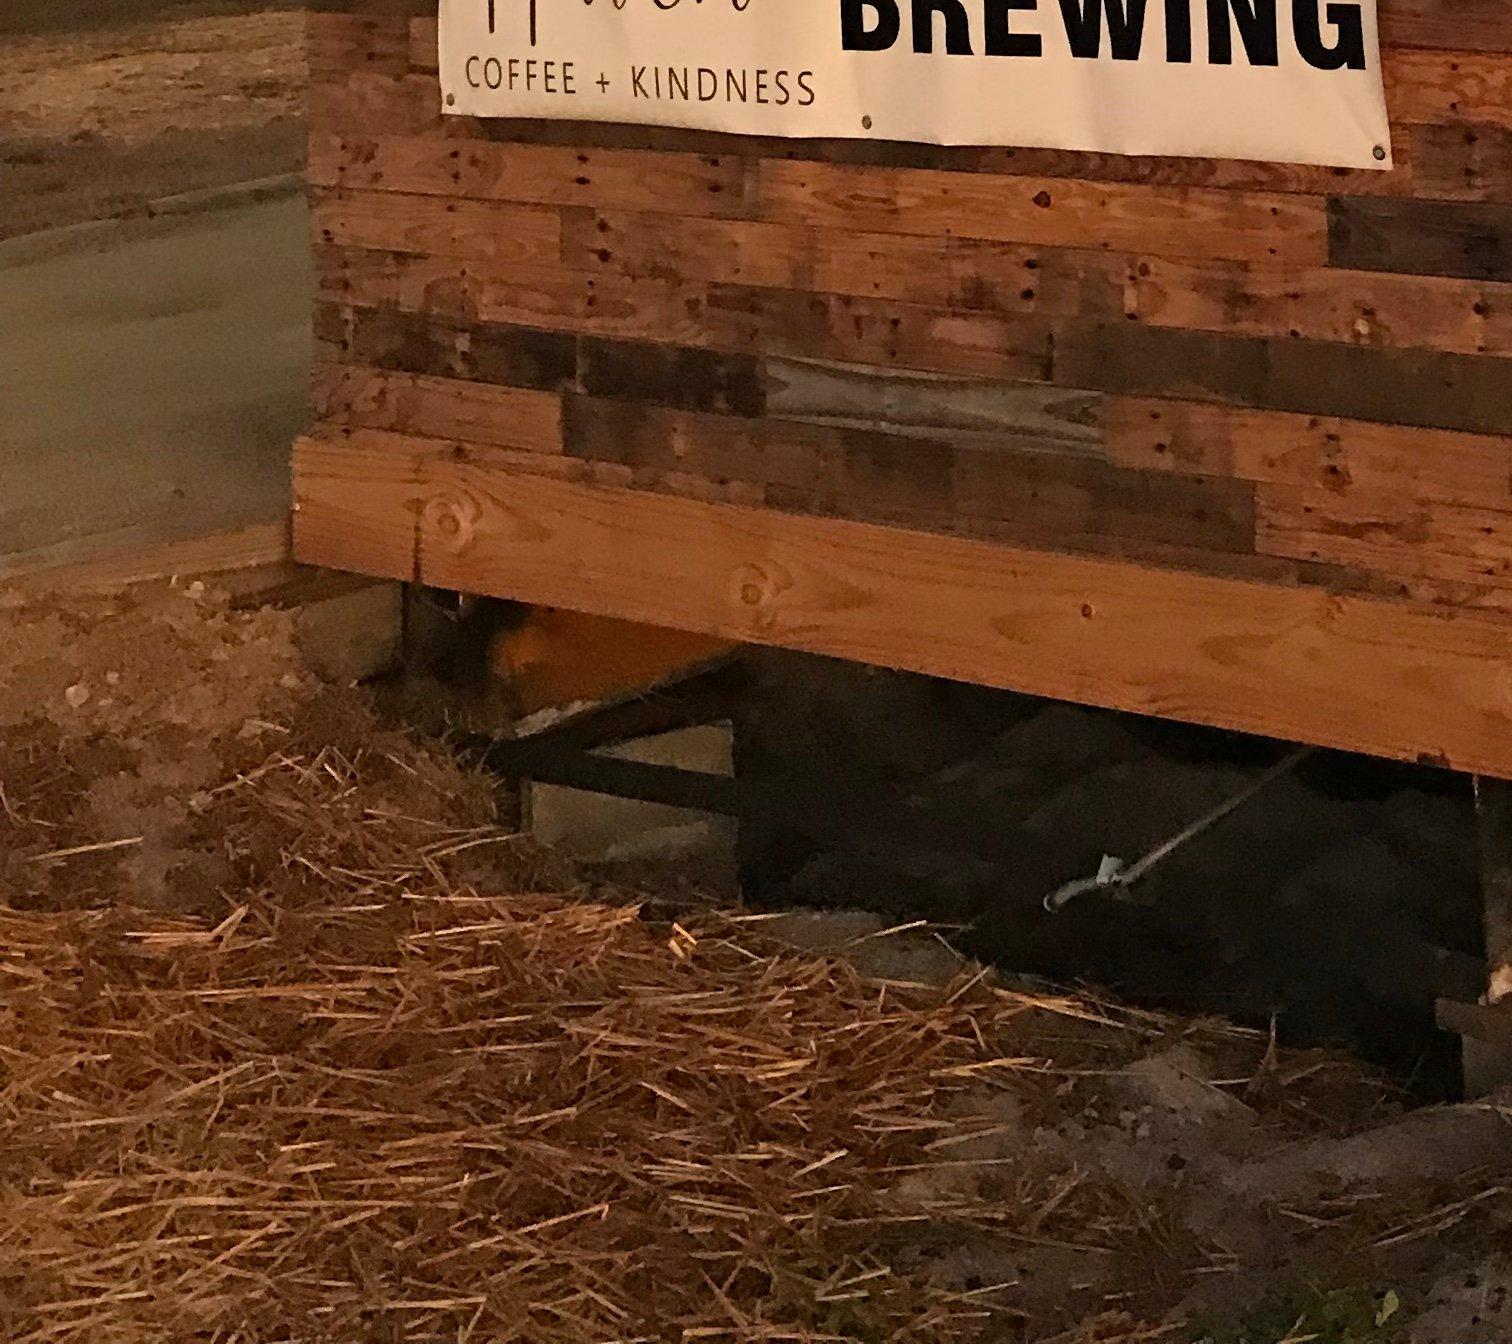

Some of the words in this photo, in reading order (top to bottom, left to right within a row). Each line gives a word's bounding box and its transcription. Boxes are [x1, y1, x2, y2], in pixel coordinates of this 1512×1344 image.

[465, 54, 577, 95] COFFEE
[594, 71, 612, 94] +
[631, 65, 815, 106] KINDNESS
